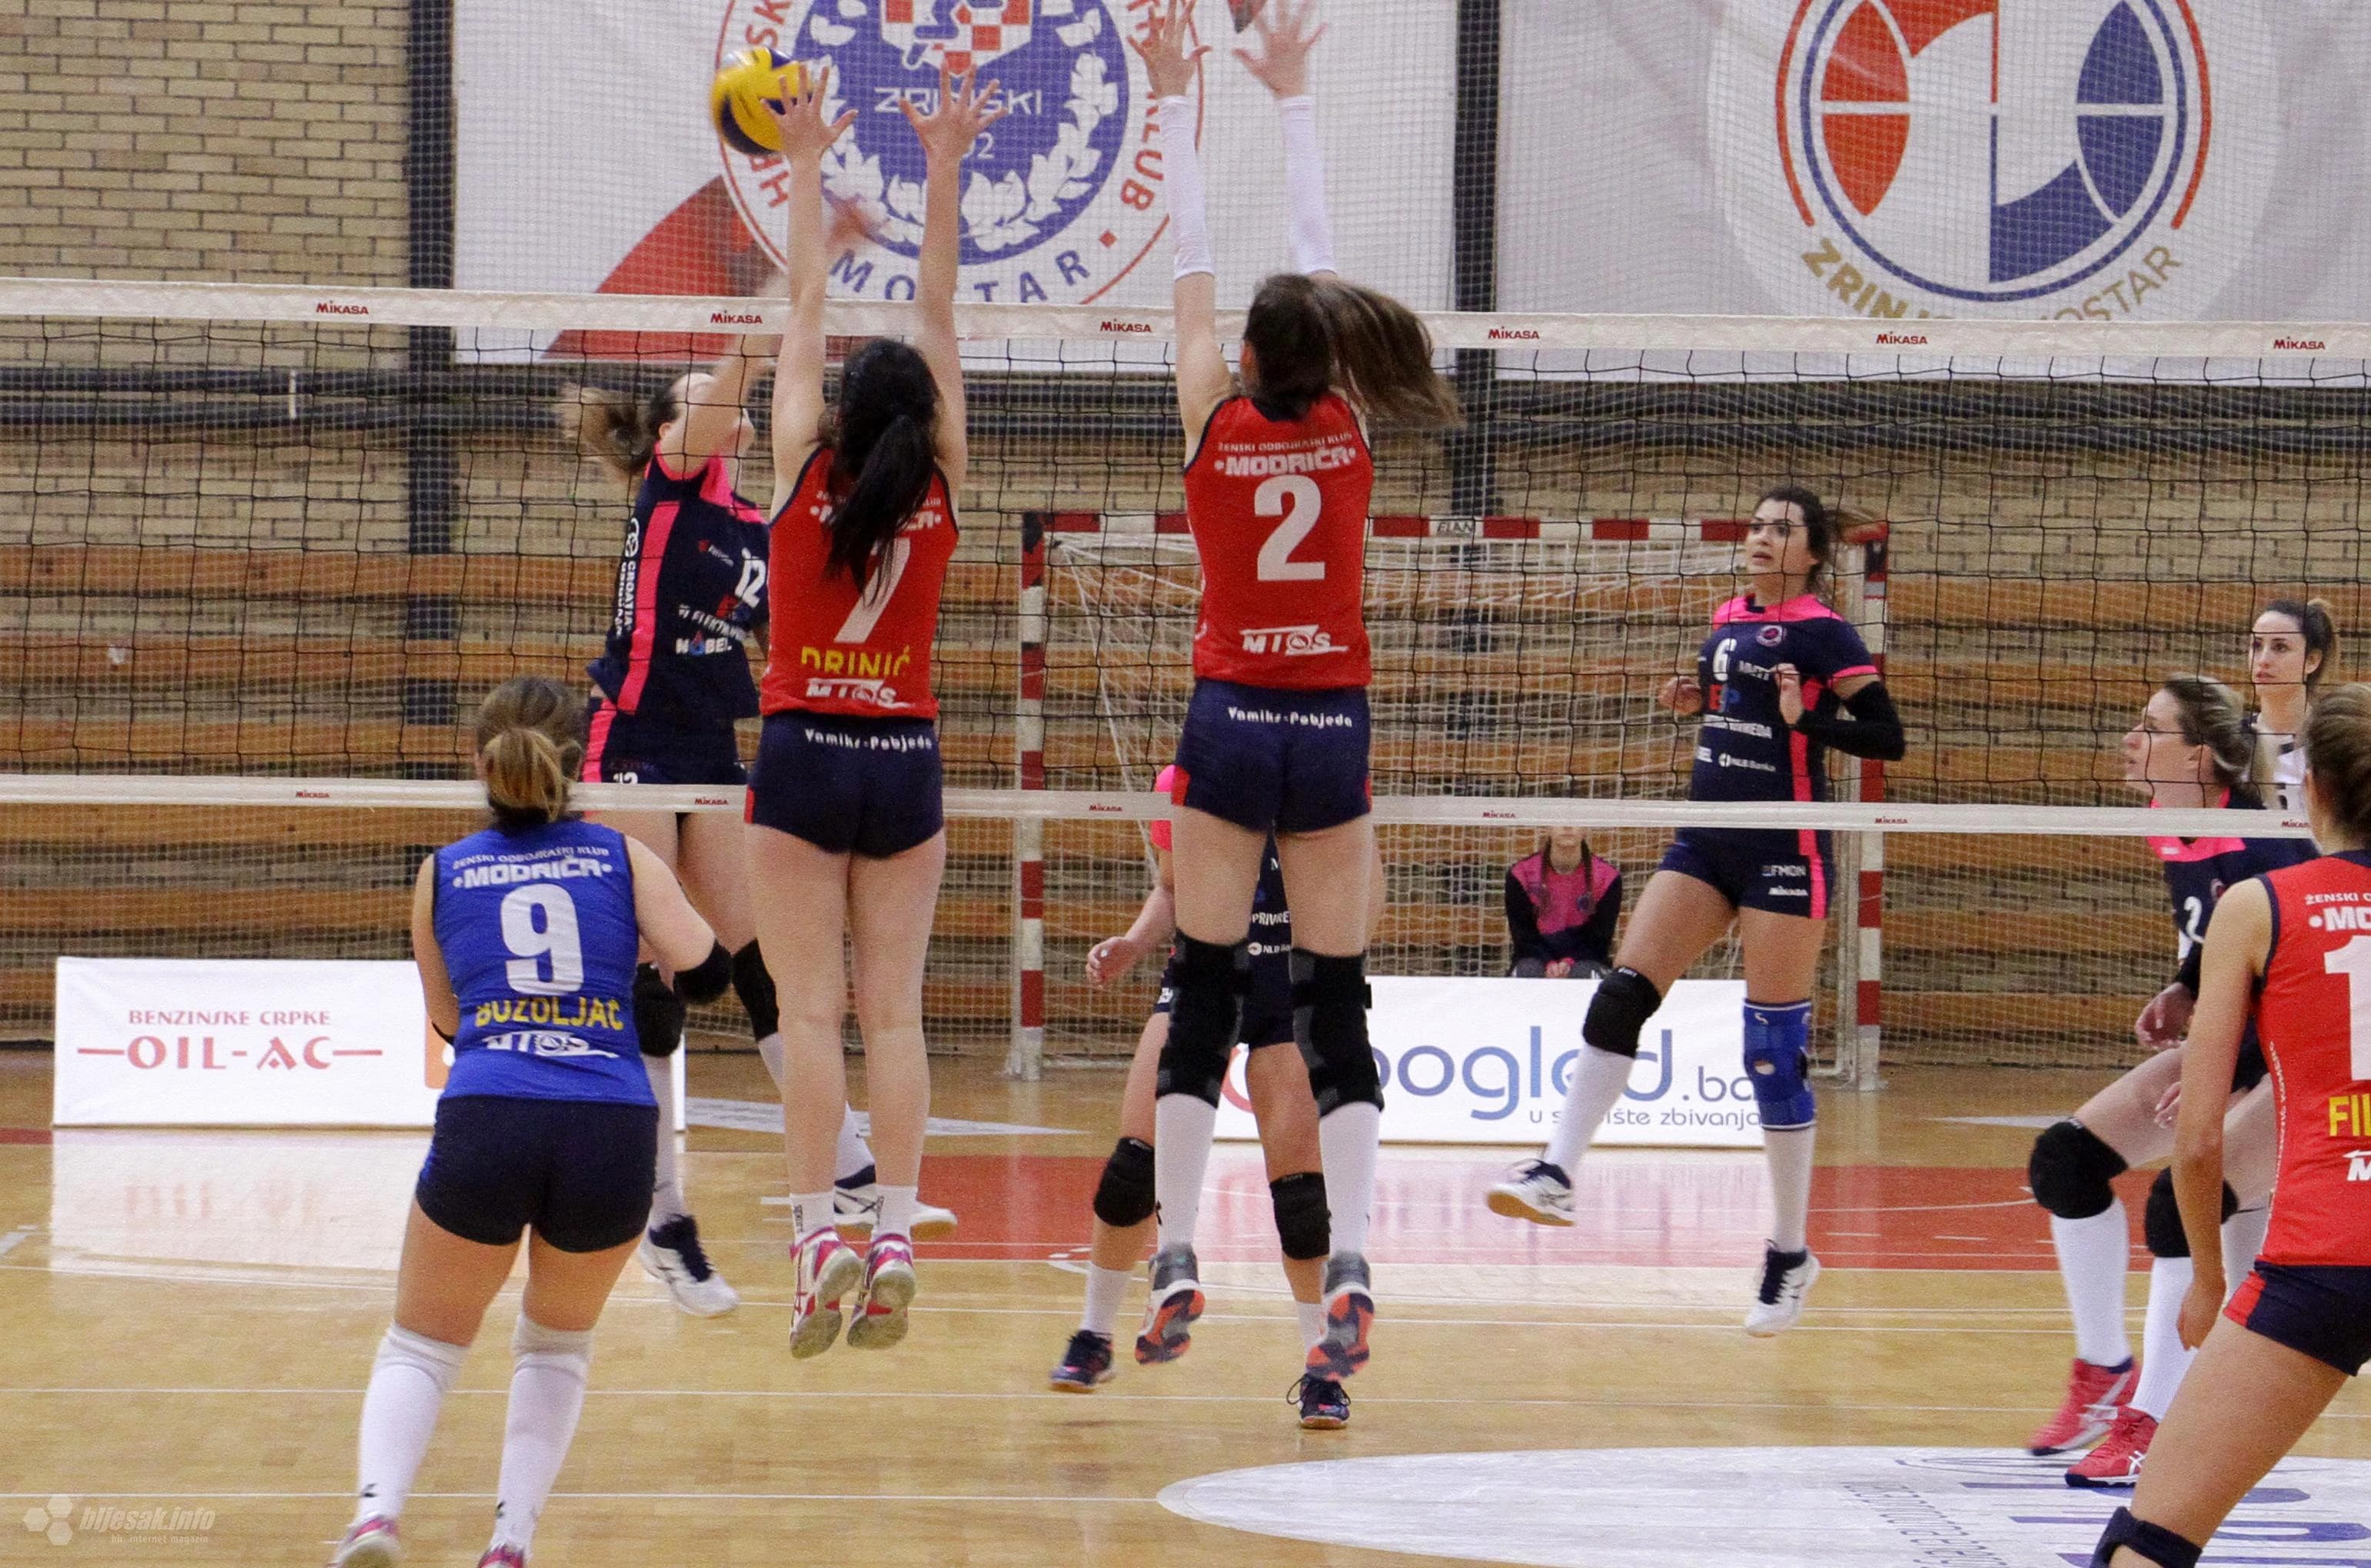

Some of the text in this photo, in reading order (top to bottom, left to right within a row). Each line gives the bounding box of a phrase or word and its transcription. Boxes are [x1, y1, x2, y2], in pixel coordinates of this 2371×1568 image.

[873, 87, 1043, 115] ZRISKI
[829, 247, 1091, 304] MOTAR
[1253, 474, 1325, 583] 2
[734, 546, 767, 610] 12
[833, 537, 911, 643] 7
[1712, 637, 1738, 682] 6
[500, 882, 585, 996] 9
[128, 1008, 332, 1026] BENZINSKE CRPKE
[127, 1035, 332, 1071] OIL-AC
[1551, 1107, 1651, 1126] sište
